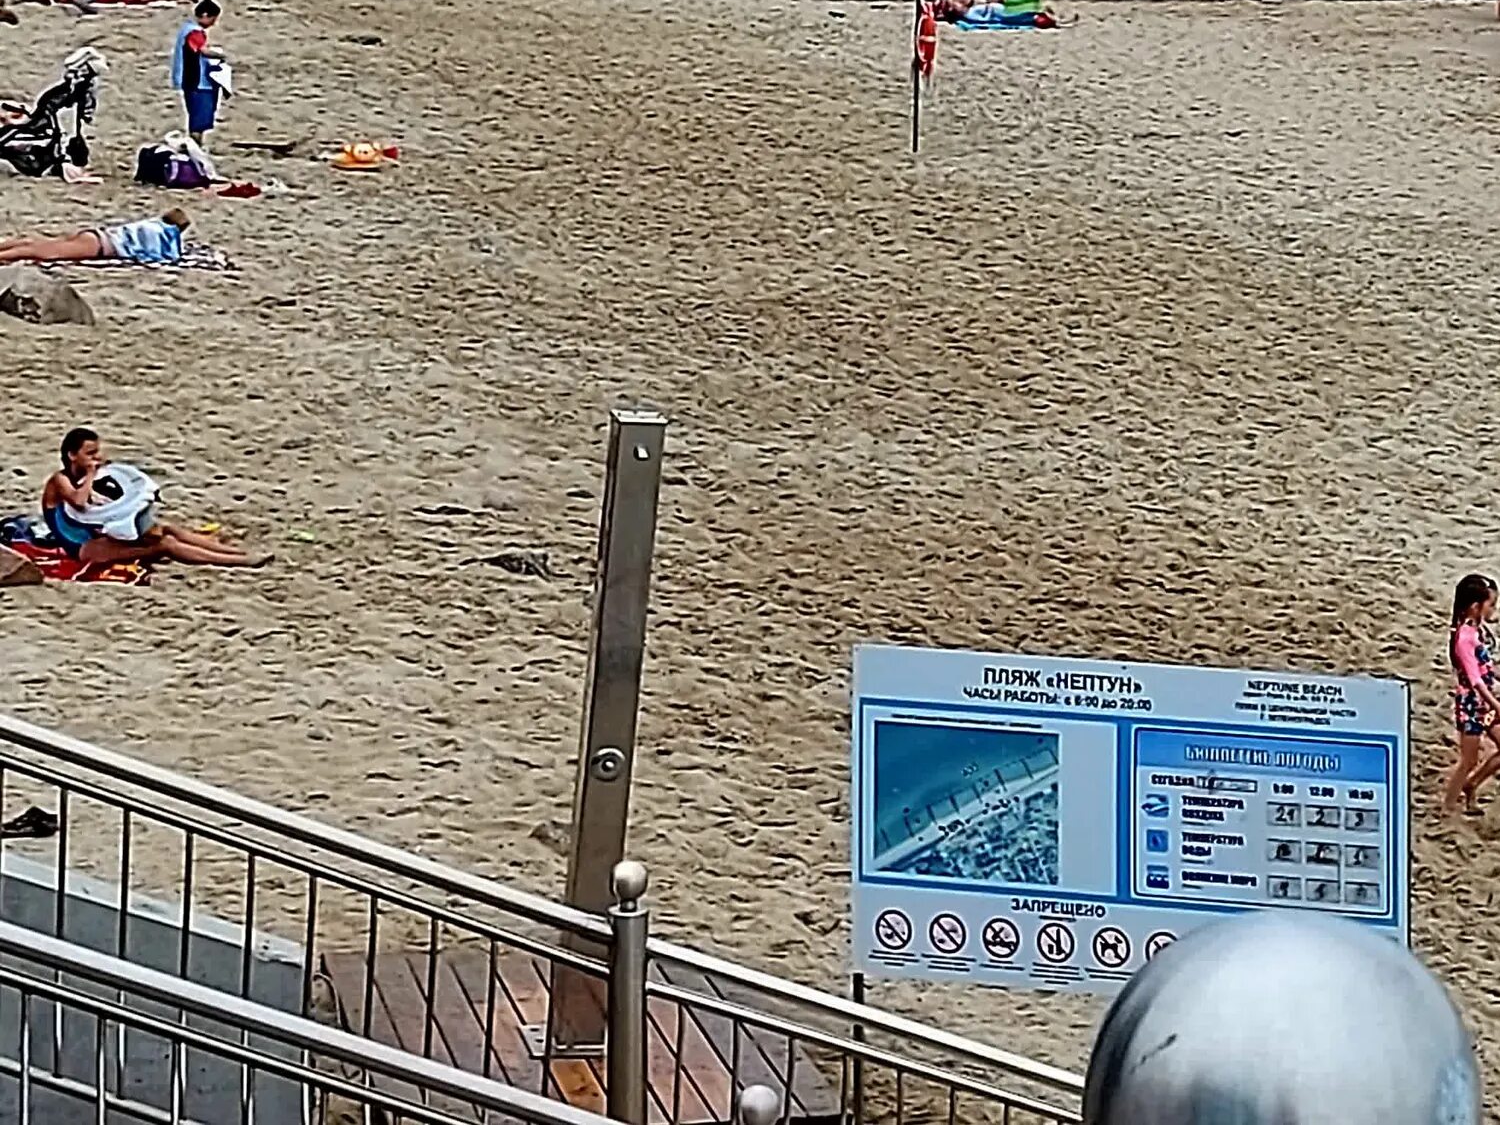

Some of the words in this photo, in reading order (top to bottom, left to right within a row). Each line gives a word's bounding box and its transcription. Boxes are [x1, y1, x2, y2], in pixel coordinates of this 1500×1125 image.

[983, 667, 1041, 688] ПЛЯЖ
[1046, 672, 1142, 694] «НЕПТУН»
[1247, 680, 1300, 694] NEPTUNE
[1302, 683, 1342, 696] BEACH
[963, 686, 1001, 700] ЧАСЫ
[1184, 743, 1271, 766] БЮЛЛЕТЕНЬ
[1274, 750, 1341, 773] ПОГОДЫ
[1010, 897, 1106, 918] ЗАПРЕЩЕНО
